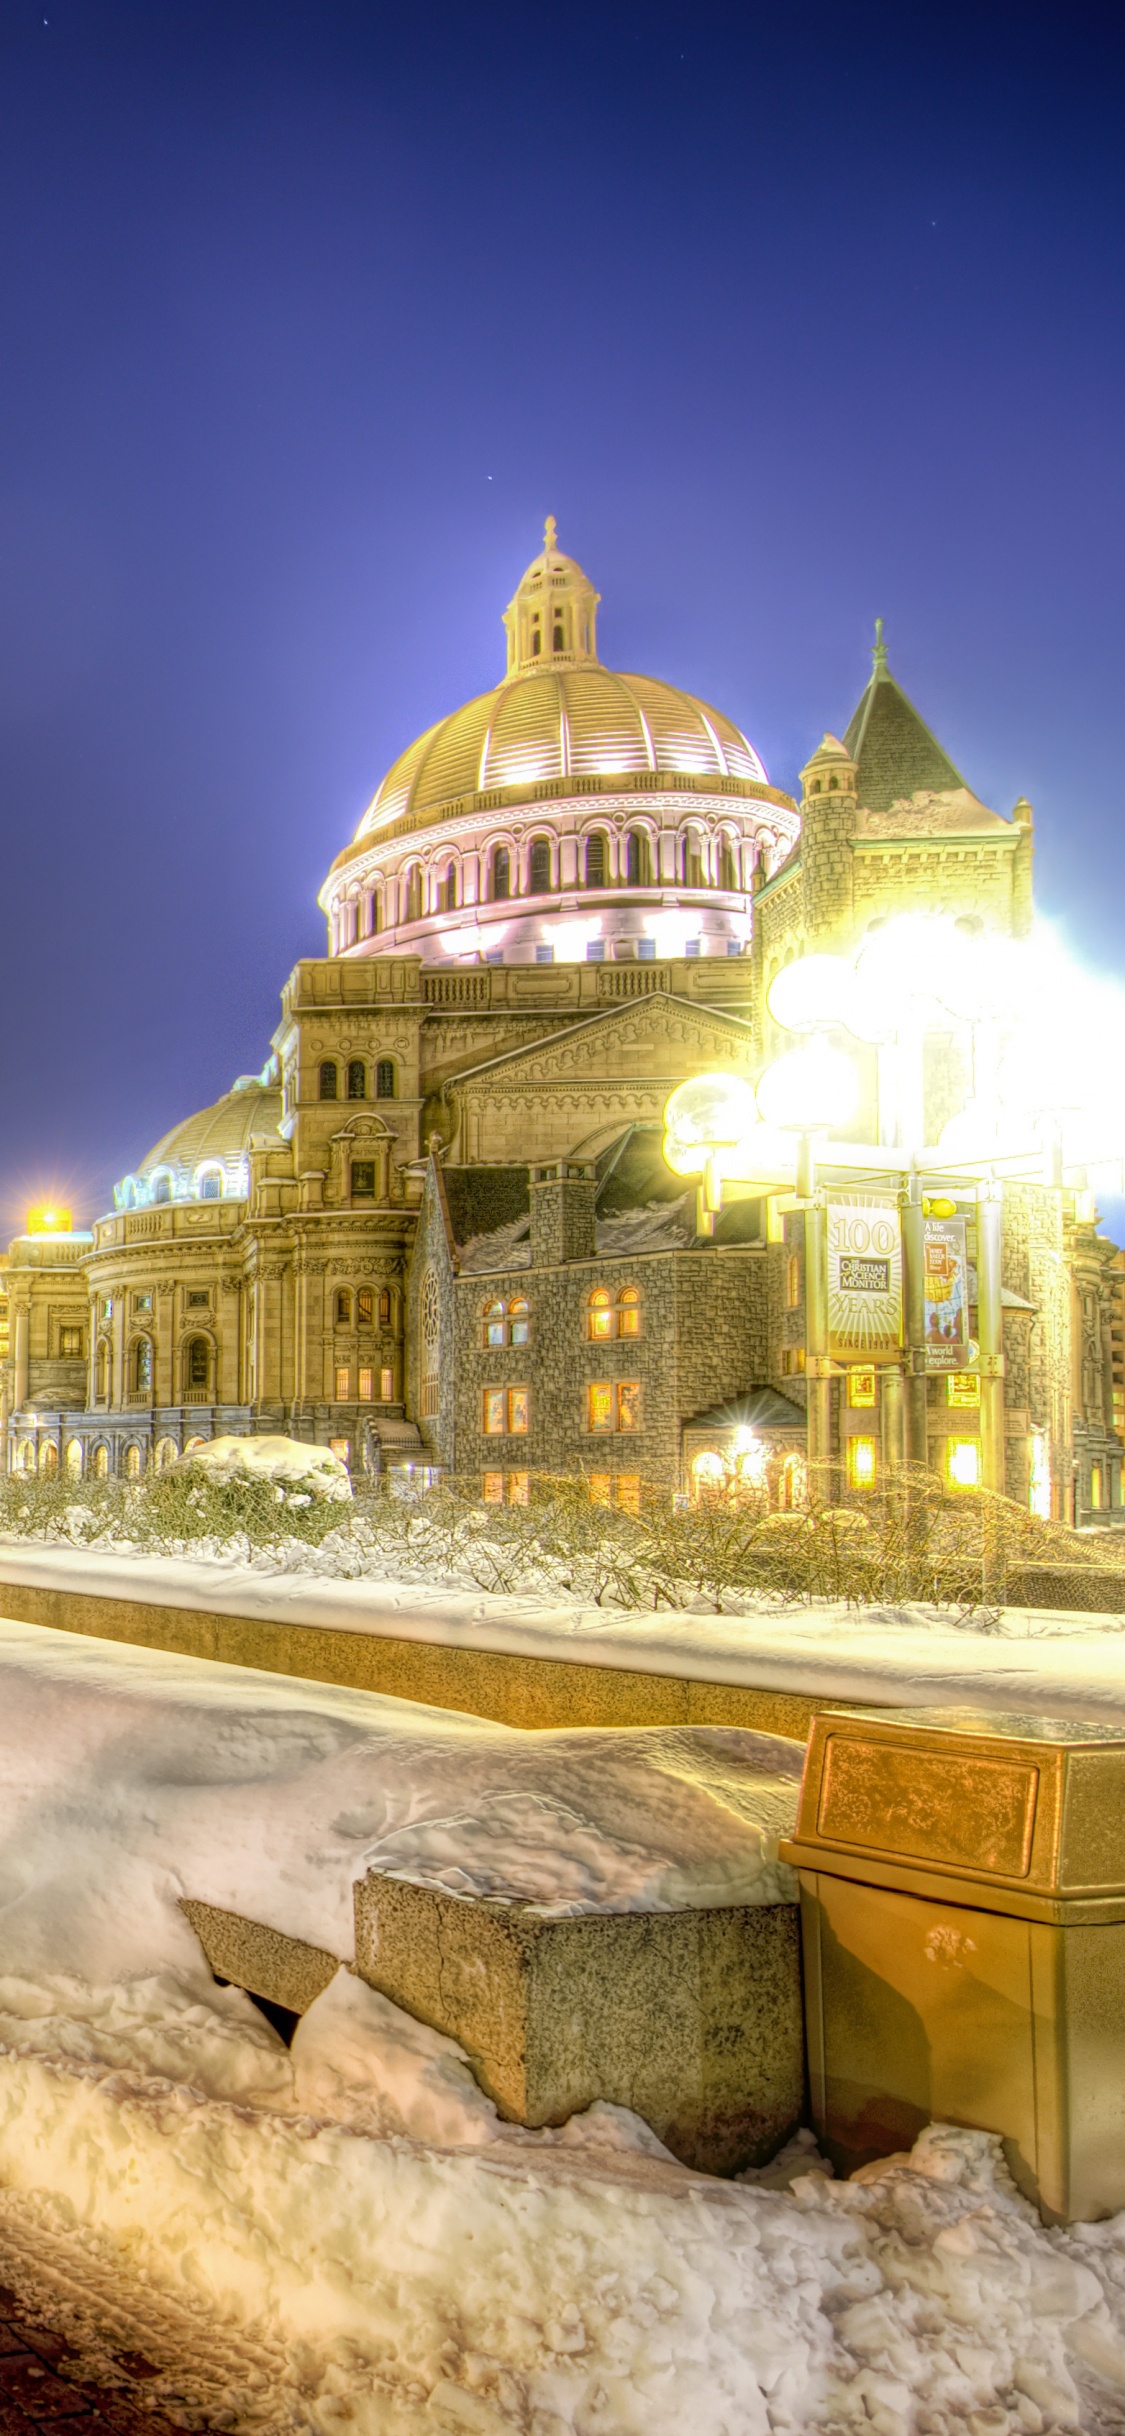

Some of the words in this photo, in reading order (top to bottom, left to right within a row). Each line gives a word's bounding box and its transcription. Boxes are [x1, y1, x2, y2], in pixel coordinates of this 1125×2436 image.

[932, 1222, 944, 1232] life
[834, 1219, 895, 1255] 100
[841, 1261, 887, 1273] CHRISTIAN
[850, 1270, 887, 1281] SCIENCE
[842, 1276, 888, 1289] MONITOR
[832, 1293, 898, 1316] YEARS
[838, 1338, 865, 1349] SINCE
[931, 1345, 953, 1355] world
[928, 1355, 958, 1367] explore.
